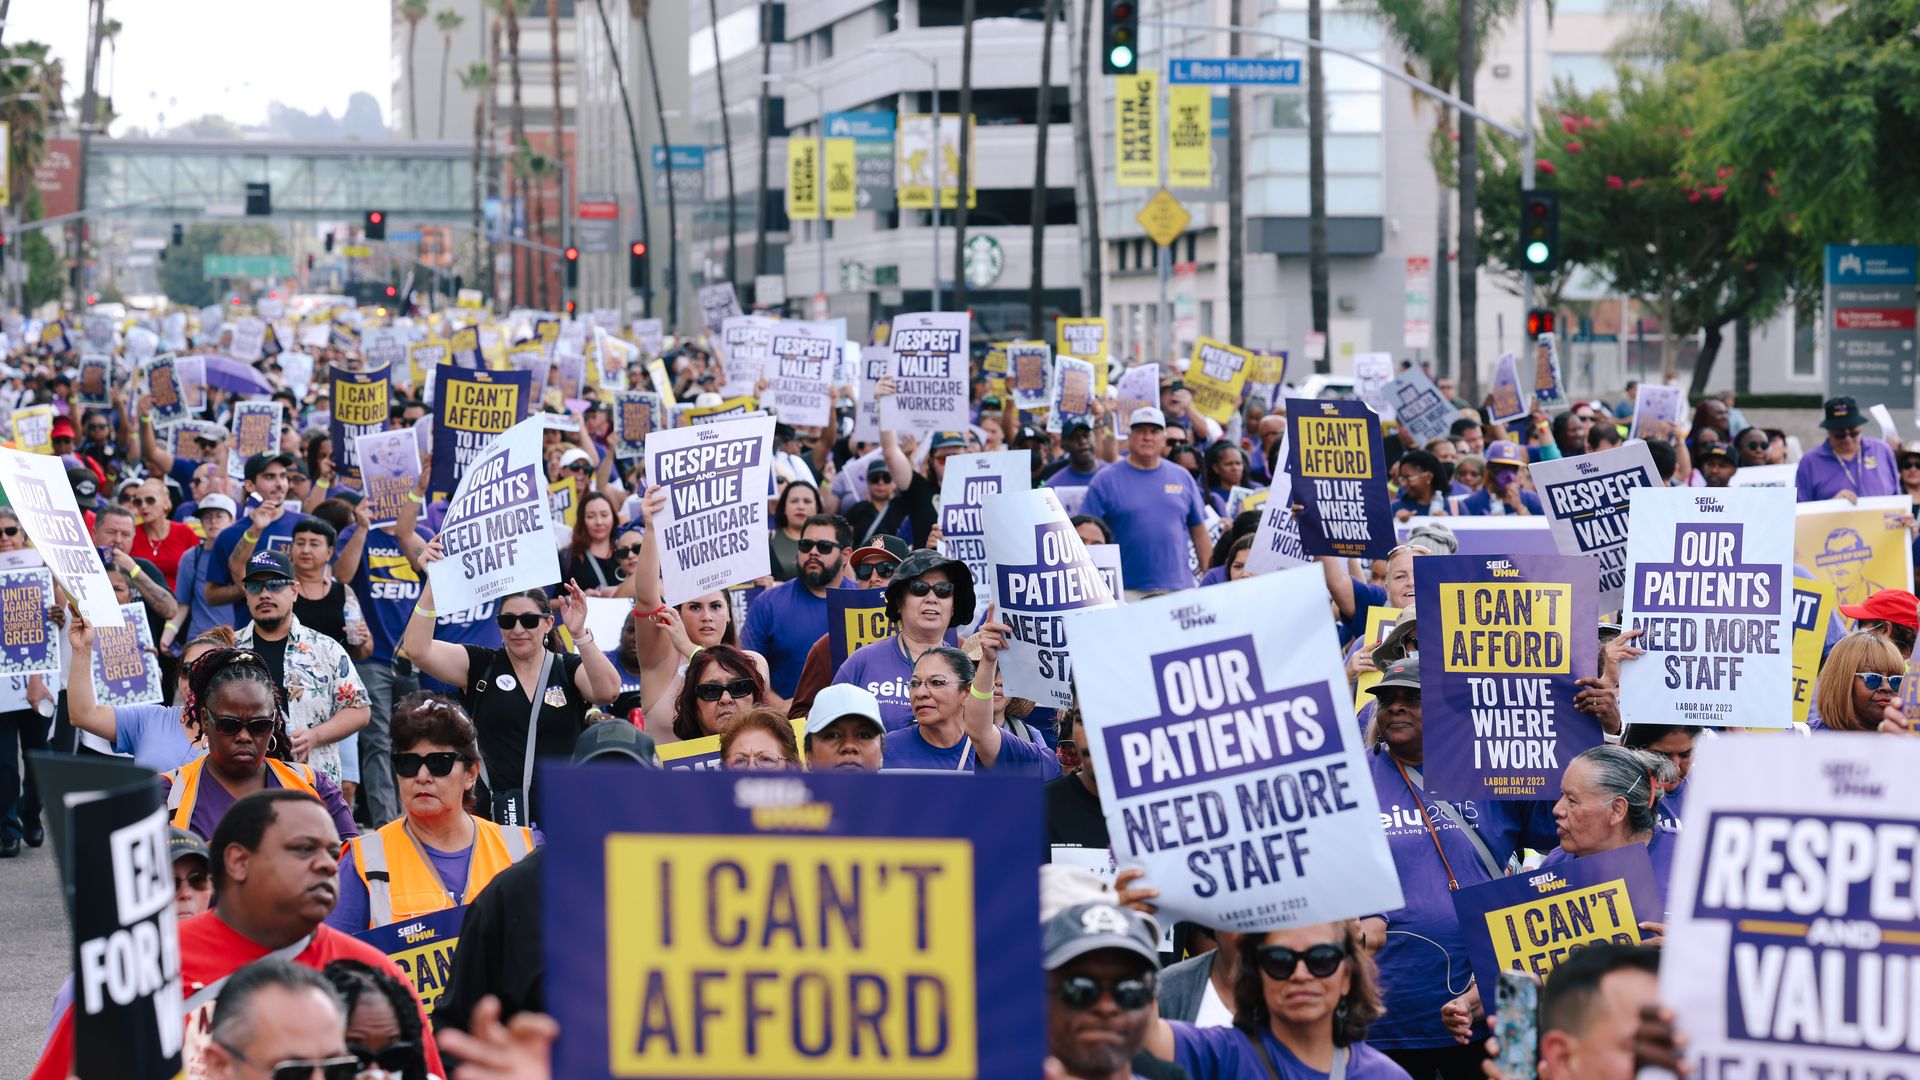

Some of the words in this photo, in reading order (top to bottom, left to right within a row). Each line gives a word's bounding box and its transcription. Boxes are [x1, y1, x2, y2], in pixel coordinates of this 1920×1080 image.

[1190, 63, 1223, 79] Ron
[1225, 63, 1295, 79] Hubbard
[1122, 99, 1136, 162] KEITH
[1137, 80, 1152, 162] HARING
[775, 337, 831, 358] RESPECT
[895, 330, 959, 352] RESPECT
[781, 359, 821, 380] VALUE
[900, 356, 948, 377] VALUE
[348, 384, 385, 403] CAN'T
[455, 384, 460, 403] I
[465, 386, 514, 407] CAN'T
[896, 380, 963, 396] EALTHCARE
[338, 401, 385, 421] AFFORD
[896, 396, 955, 412] WORKERS
[448, 406, 512, 430] AFFORD
[455, 431, 473, 447] TO
[1306, 421, 1312, 446] I
[1315, 421, 1363, 447] CAN'T
[660, 439, 758, 482] RESPECT
[1304, 449, 1367, 475] AFFORD
[1581, 466, 1600, 475] UHW
[469, 456, 505, 491] OUR
[695, 471, 717, 482] AND
[446, 472, 530, 526] PATIENTS
[674, 474, 739, 516] VALUE
[1313, 479, 1332, 500] TO
[1334, 480, 1365, 501] LIVE
[1551, 470, 1642, 514] RESPECT
[1694, 496, 1719, 505] SEIU-
[1316, 500, 1368, 521] WHERE
[1594, 506, 1616, 517] AND
[1699, 504, 1724, 513] UHW
[485, 504, 544, 544] MORE
[664, 502, 760, 551] HEALTHCARE
[947, 509, 983, 533] PATI
[1320, 520, 1329, 539] I
[1327, 520, 1372, 541] WORK
[1575, 511, 1630, 549] VALU
[461, 539, 518, 580] STAFF
[677, 529, 750, 571] WORKERS
[945, 539, 986, 560] NEED
[1681, 531, 1736, 567] OUR
[1486, 560, 1512, 569] SEIU-
[1493, 569, 1520, 578] UHW
[1, 586, 42, 601] UNITED
[370, 582, 420, 600] SEIU
[1643, 570, 1771, 609] PATIENTS
[2, 600, 42, 612] AGAINST
[3, 610, 42, 623] KAISER'S
[1457, 589, 1467, 626] I
[1474, 588, 1563, 626] CAN'T
[3, 621, 44, 633] CORPORATE
[857, 613, 865, 639] I
[1002, 612, 1068, 648] NEED
[1180, 613, 1218, 630] UHW
[4, 629, 44, 647] GREED
[1631, 617, 1698, 653] NEED
[1704, 618, 1781, 655] MORE
[1451, 630, 1563, 668] AFFORD
[105, 663, 144, 681] GREED
[1162, 649, 1257, 717] OUR
[1664, 655, 1744, 691] STAFF
[1050, 690, 1071, 701] LABOR
[1467, 677, 1498, 707] TO
[1502, 678, 1555, 707] LIVE
[1675, 701, 1699, 712] LABOR
[1699, 702, 1714, 712] DAY
[1715, 703, 1733, 713] 2023
[1684, 711, 1725, 722] #UNITED4ALL
[1471, 708, 1557, 738] WHERE
[1120, 695, 1326, 789] PATIENTS
[1474, 740, 1482, 769] I
[1486, 739, 1559, 769] WORK
[1484, 777, 1509, 786] LABOR
[1510, 777, 1525, 786] DAY
[1526, 777, 1546, 786] 2023
[1493, 786, 1537, 795] #UNITED4ALL
[1121, 790, 1230, 857] NEED
[1235, 761, 1359, 833] MORE
[1379, 804, 1423, 829] eiu
[1187, 827, 1311, 899] STAFF
[1702, 816, 1920, 922] RESPE
[1528, 872, 1558, 887] SEIU-
[1537, 878, 1567, 894] UHW
[658, 859, 674, 949] I
[704, 858, 945, 953] CAN'T
[1218, 908, 1253, 922] LABOR
[1257, 903, 1277, 916] DAY
[397, 922, 427, 939] SEIU-
[1505, 914, 1522, 953] I
[1524, 887, 1621, 948] CAN'T
[406, 928, 437, 944] UHW
[1805, 916, 1884, 951] AND
[633, 967, 952, 1060] AFFORD
